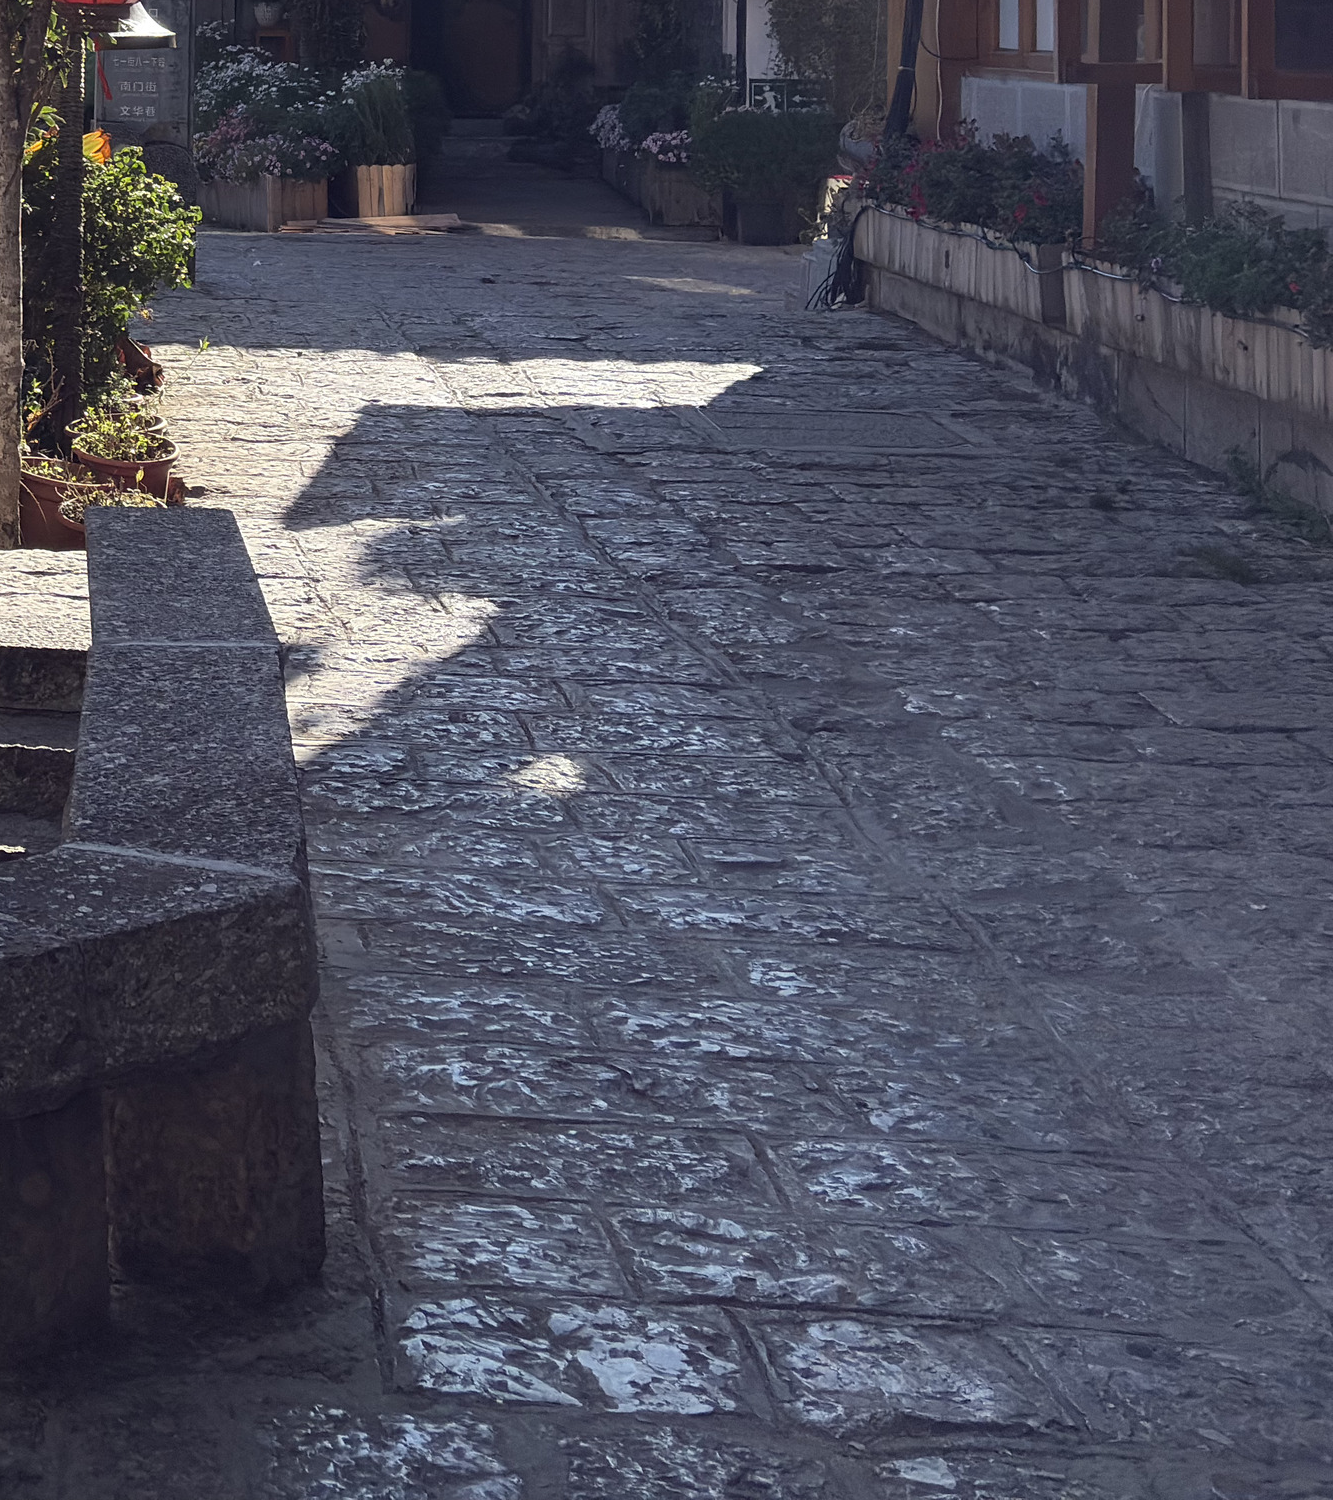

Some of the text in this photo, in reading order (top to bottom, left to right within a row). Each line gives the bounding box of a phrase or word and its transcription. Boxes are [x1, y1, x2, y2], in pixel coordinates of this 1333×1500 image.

[119, 80, 157, 93] 南门街
[119, 105, 157, 117] 文华巷
